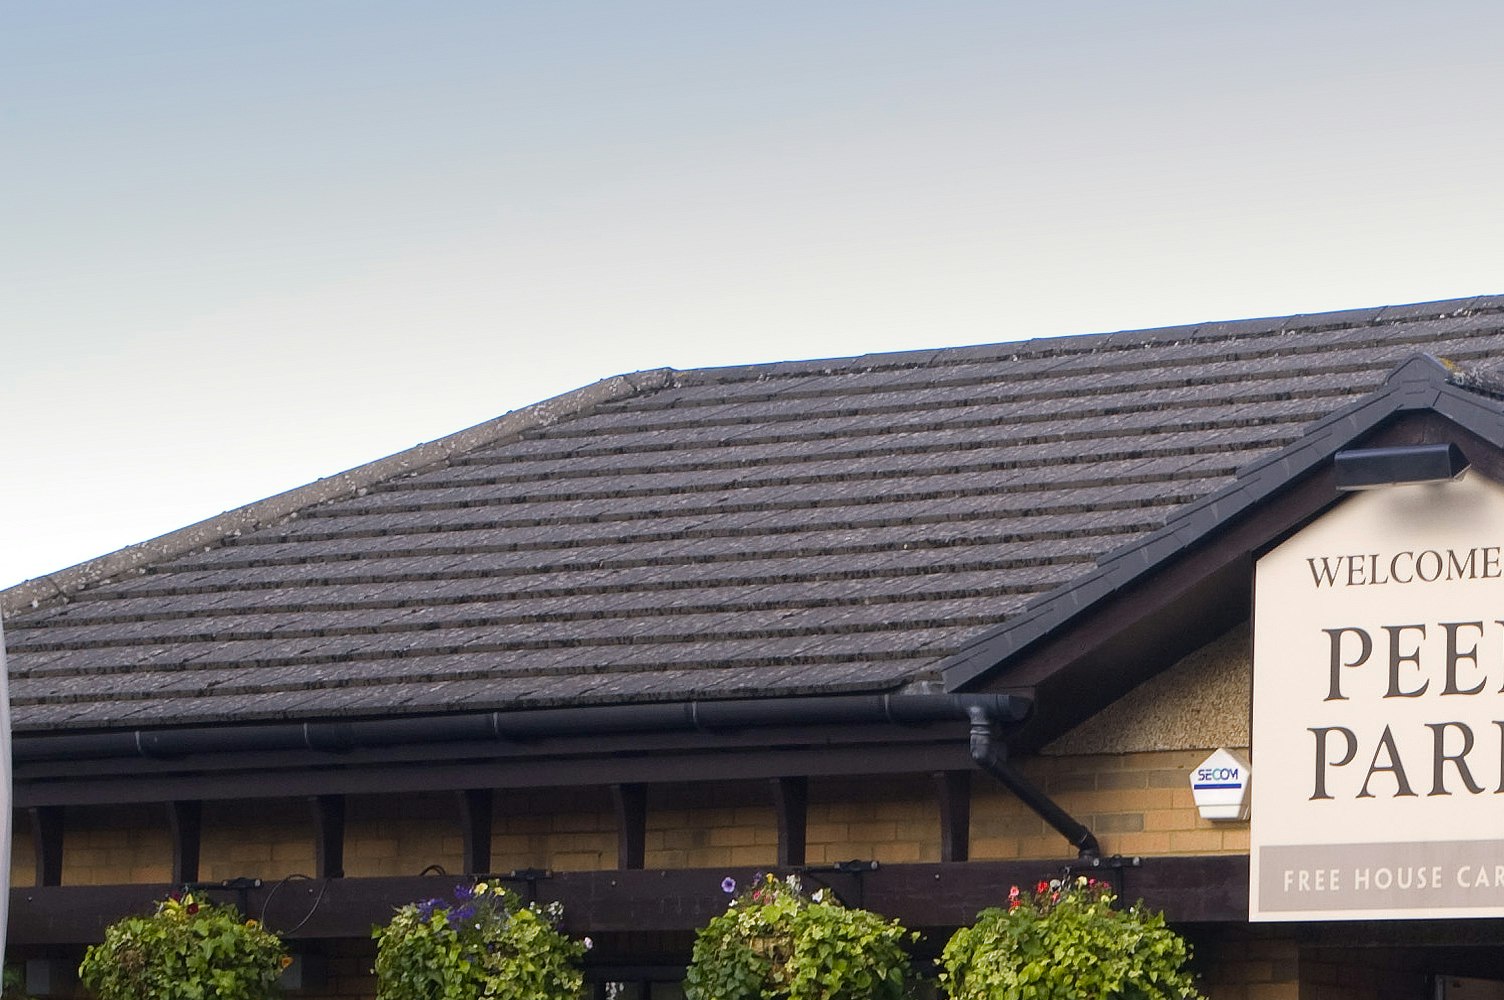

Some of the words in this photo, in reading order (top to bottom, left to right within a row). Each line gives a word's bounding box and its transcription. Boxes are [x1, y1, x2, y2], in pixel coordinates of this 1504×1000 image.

[1306, 547, 1502, 588] WELCOME
[1198, 768, 1239, 781] SECOM
[1284, 869, 1340, 892] FREE
[1355, 866, 1442, 889] HOUSE
